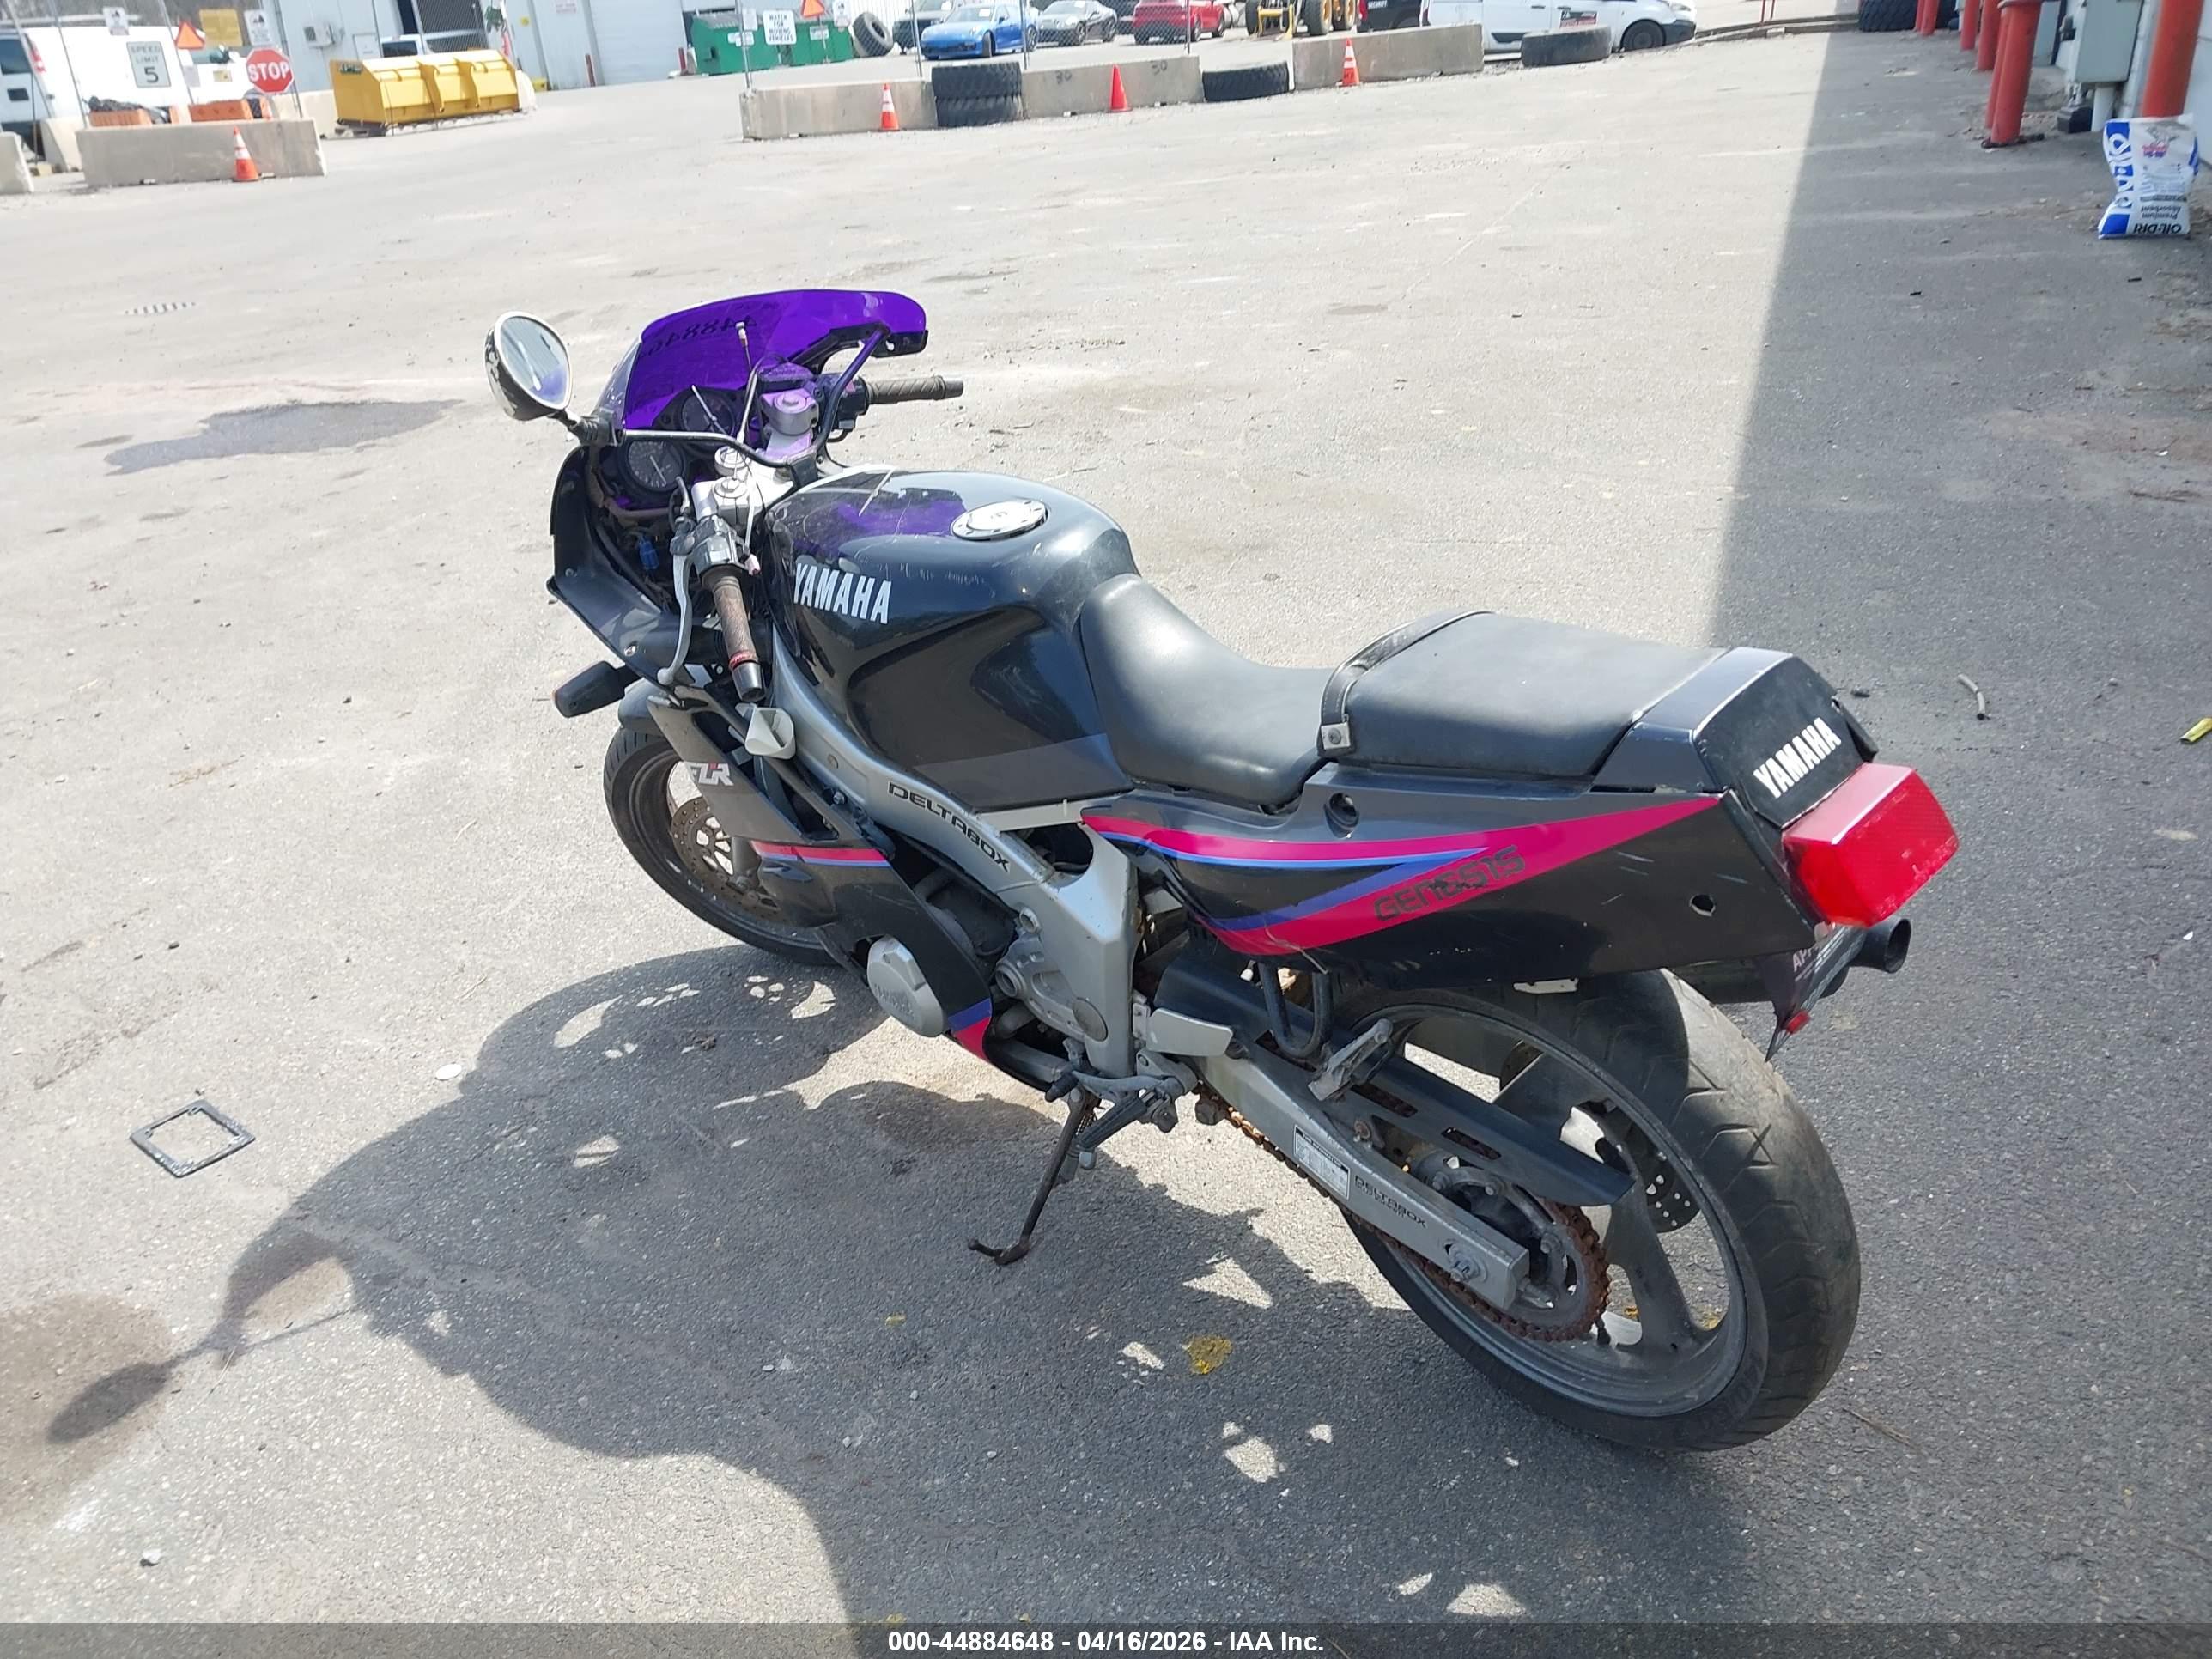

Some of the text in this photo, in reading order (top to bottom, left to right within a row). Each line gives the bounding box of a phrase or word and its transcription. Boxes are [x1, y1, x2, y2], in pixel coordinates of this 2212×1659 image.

[143, 66, 160, 83] 5
[247, 61, 290, 82] STOP
[793, 562, 892, 624] YAMAHA
[1753, 716, 1842, 799] YAMAHA
[887, 781, 1011, 873] DELTABOX
[1354, 1175, 1428, 1229] DELTABOX
